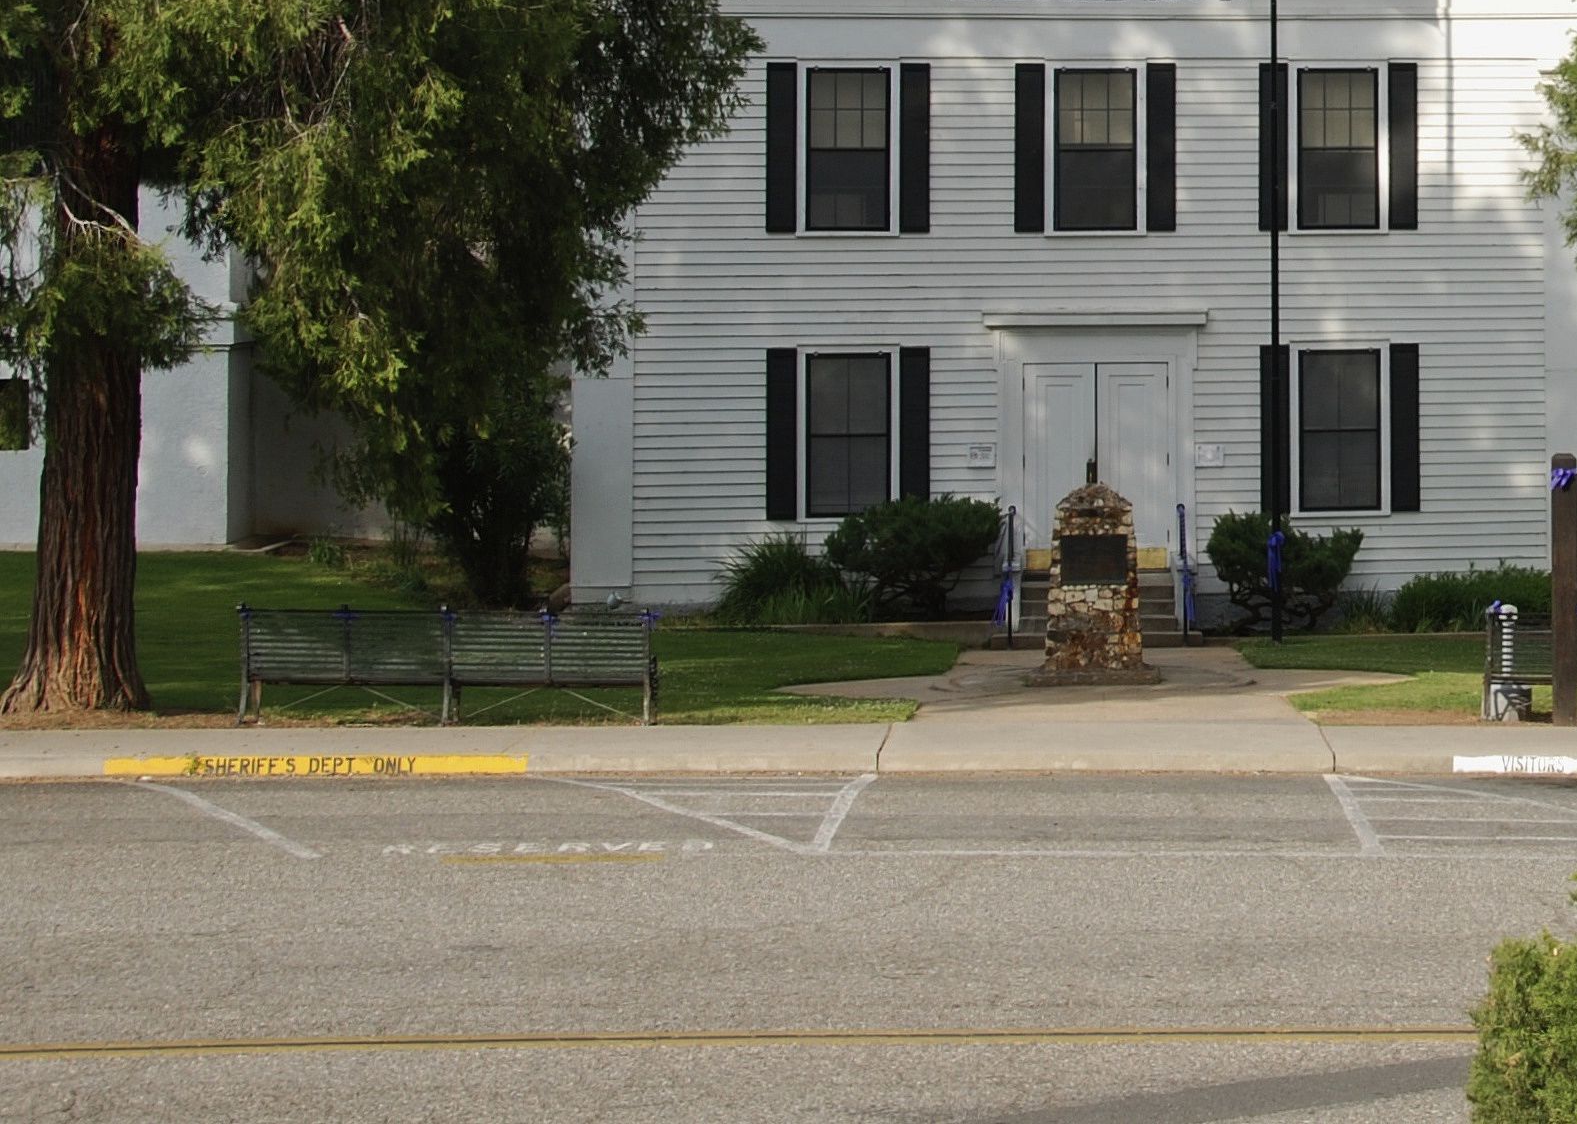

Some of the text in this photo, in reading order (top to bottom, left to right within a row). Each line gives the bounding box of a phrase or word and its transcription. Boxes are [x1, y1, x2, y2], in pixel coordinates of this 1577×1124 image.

[205, 757, 296, 774] SHERIFF'S
[373, 757, 416, 775] ONLY
[1501, 755, 1565, 773] VISITORS
